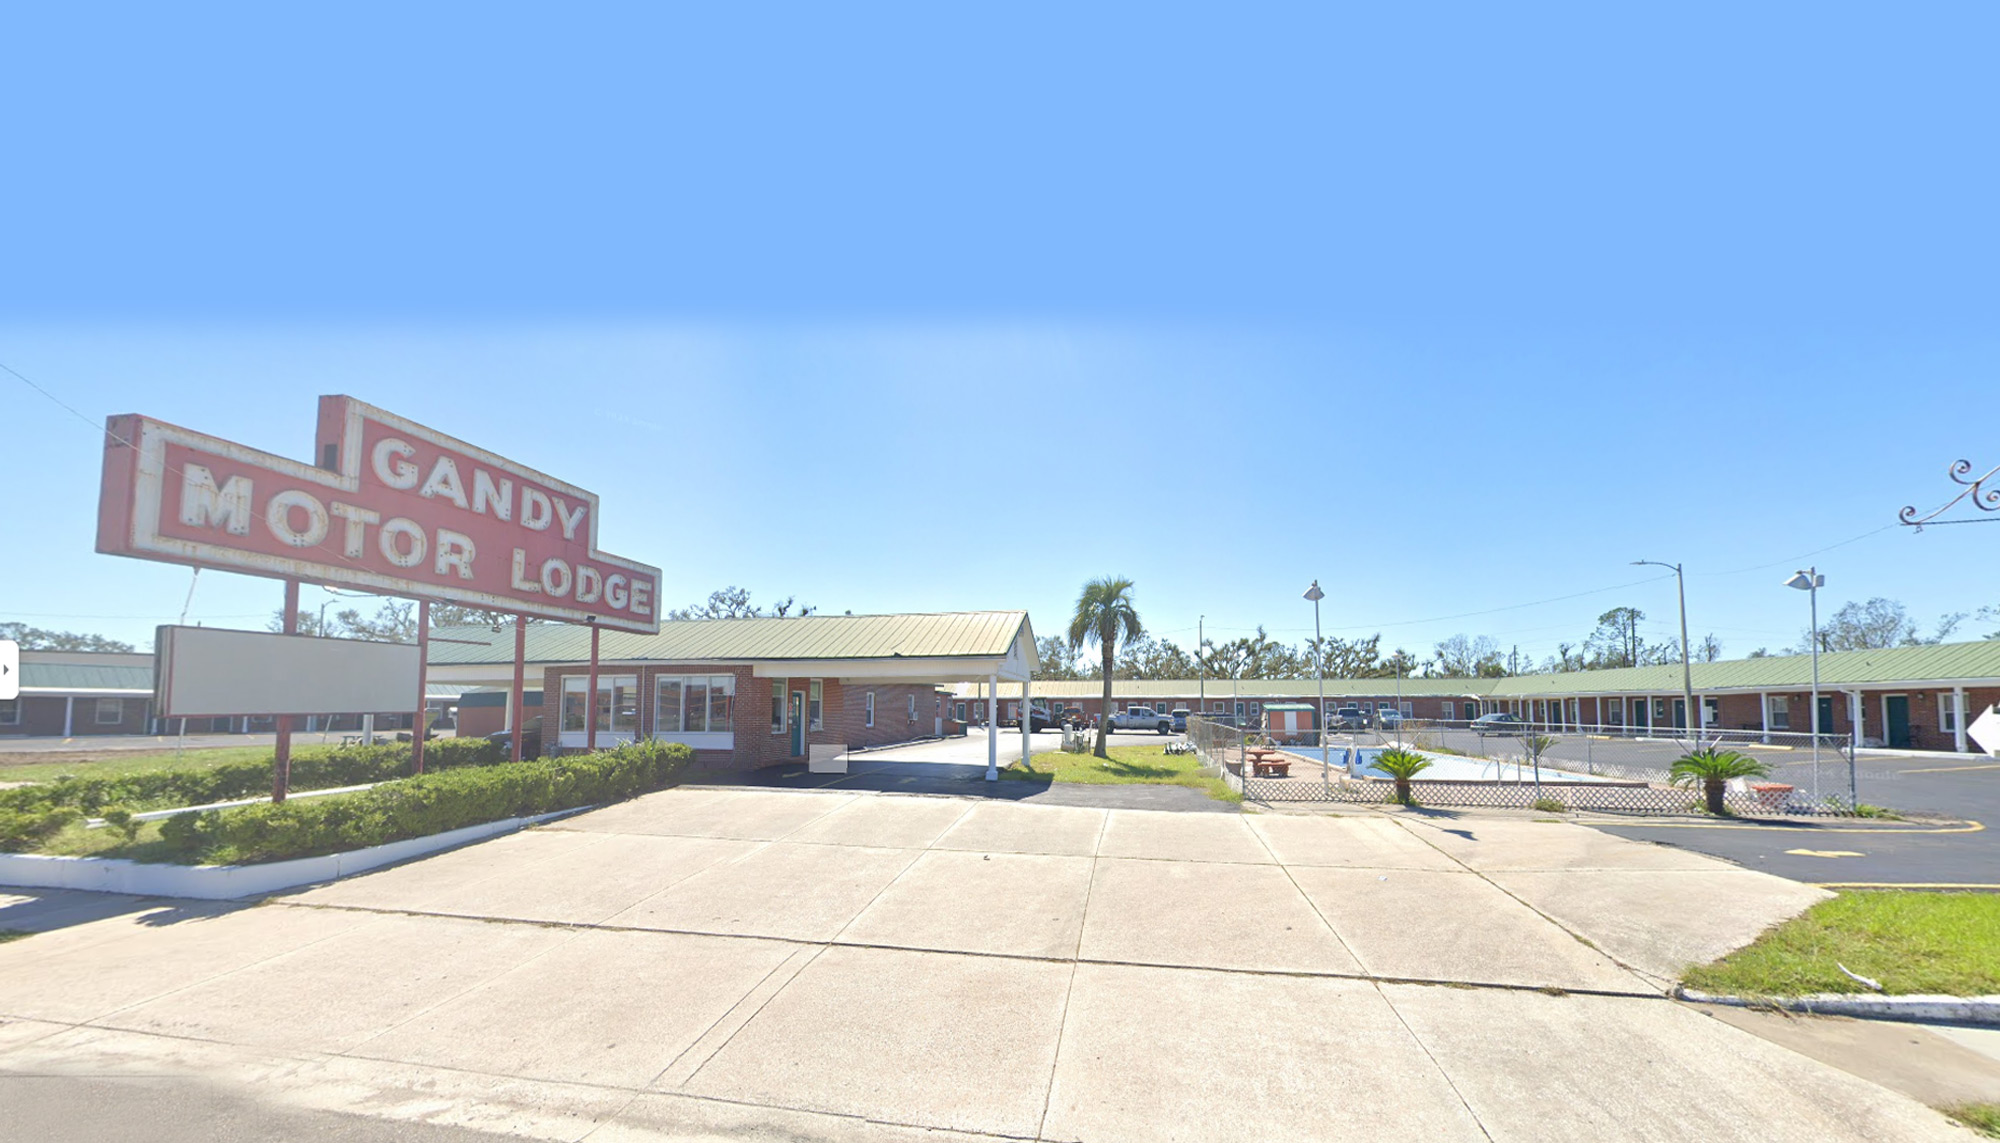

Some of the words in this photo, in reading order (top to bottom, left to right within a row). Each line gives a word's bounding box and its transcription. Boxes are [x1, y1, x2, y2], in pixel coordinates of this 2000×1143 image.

[179, 462, 475, 579] MOTOR
[512, 548, 652, 614] LODGE
[372, 438, 586, 540] GANDY
